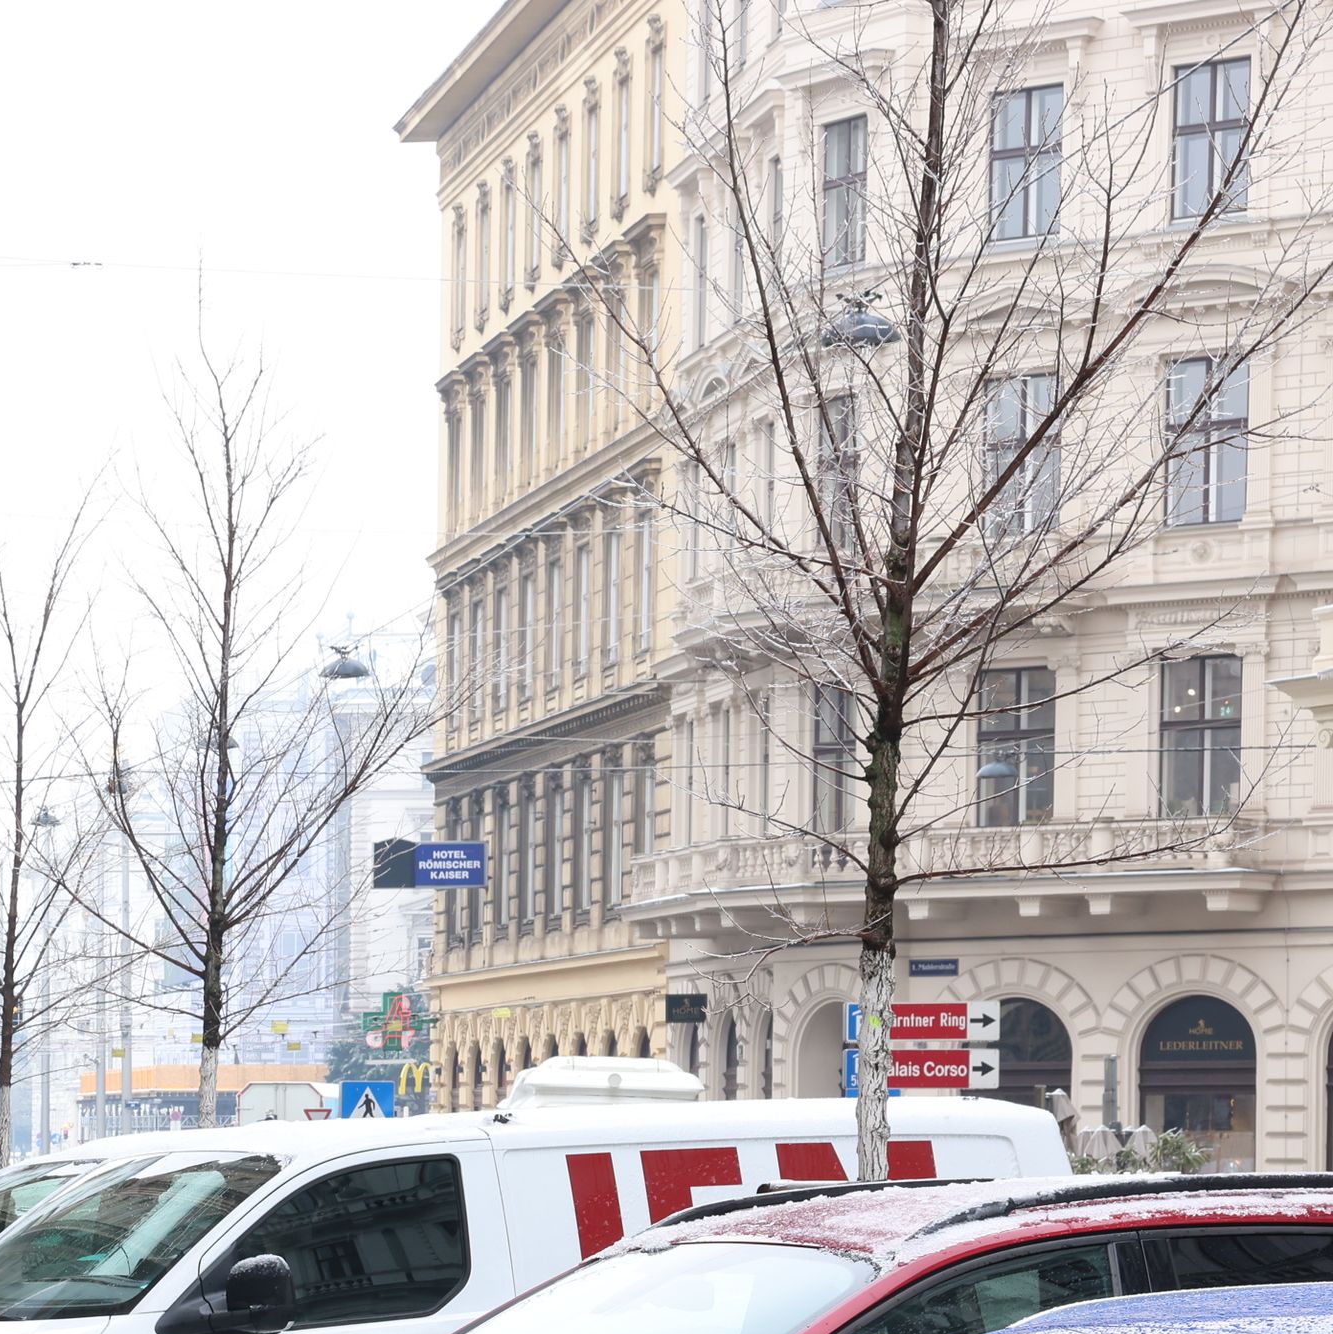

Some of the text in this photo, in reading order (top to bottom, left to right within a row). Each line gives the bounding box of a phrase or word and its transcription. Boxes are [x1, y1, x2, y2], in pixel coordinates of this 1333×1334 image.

[432, 850, 467, 859] HOTEL
[418, 859, 481, 870] RÖMISCHER
[430, 871, 469, 880] KAISER
[940, 1012, 966, 1030] Ring
[1159, 1040, 1244, 1051] LEDERLEITNER
[887, 1061, 967, 1077] alais Corso
